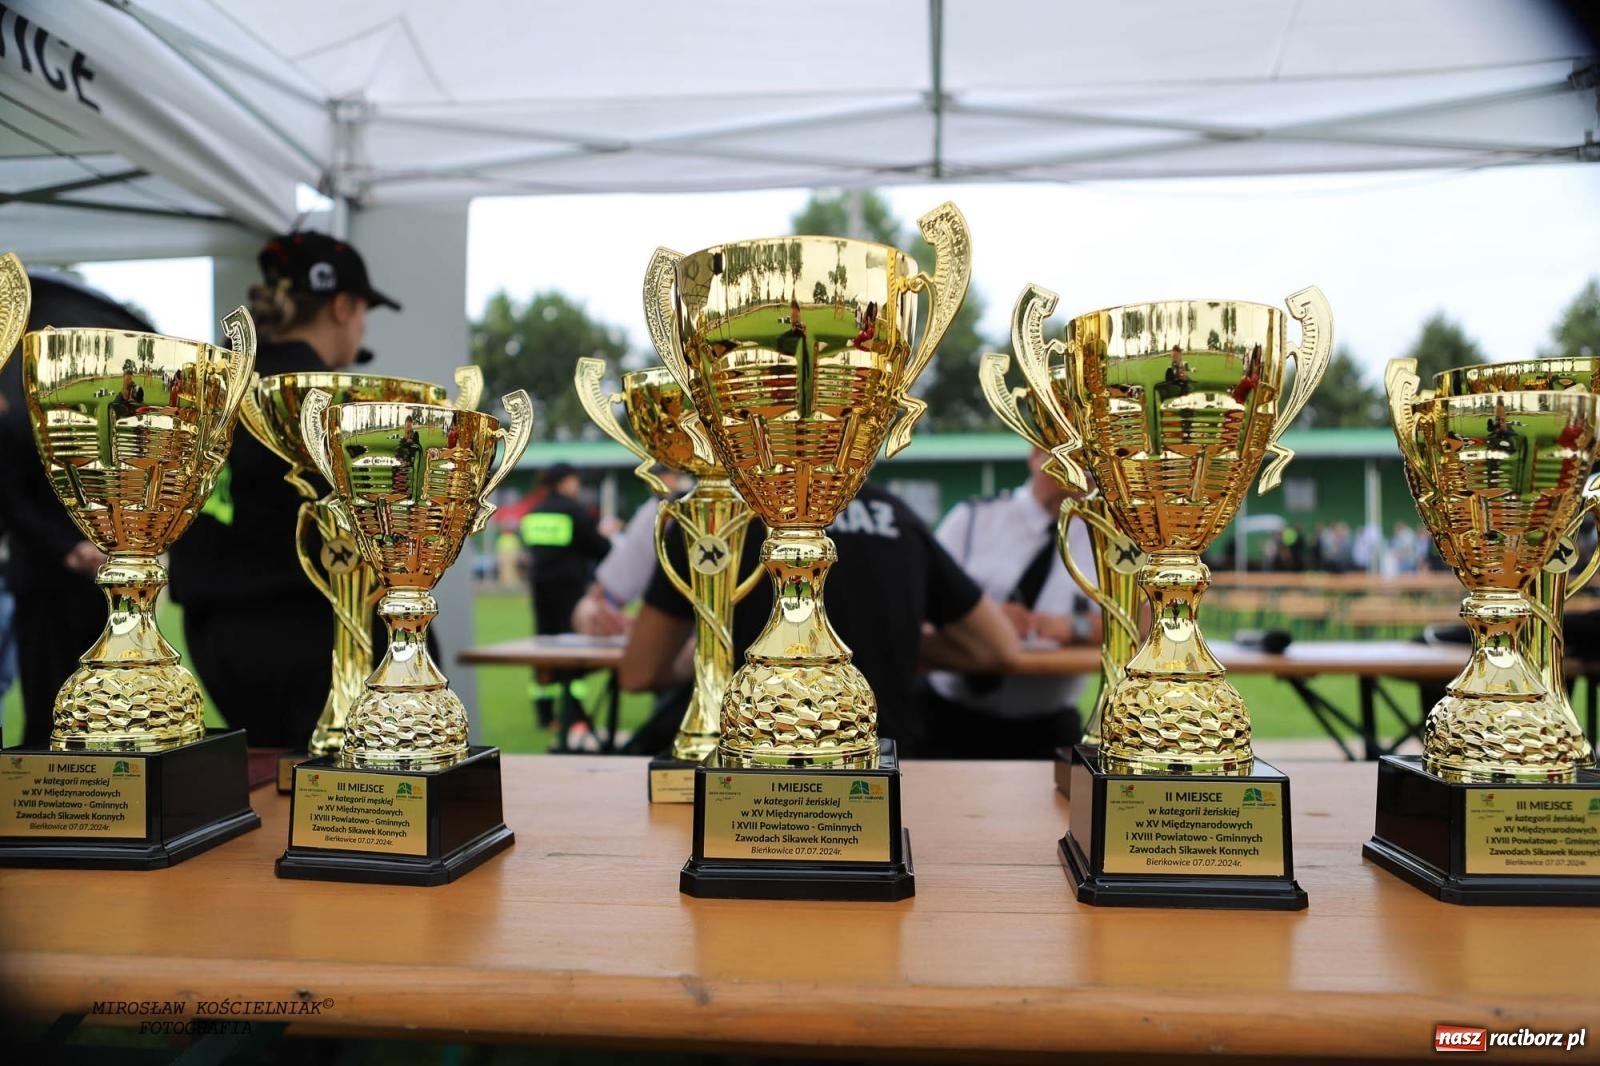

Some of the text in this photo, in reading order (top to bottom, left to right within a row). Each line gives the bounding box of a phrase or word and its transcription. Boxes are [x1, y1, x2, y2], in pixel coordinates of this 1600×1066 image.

[48, 764, 96, 773] II MIEJSCE
[43, 778, 78, 786] kategorii
[772, 782, 822, 792] I MIEJSCE
[44, 789, 120, 798] Międzynarodowych
[348, 784, 384, 793] MIEJSCE
[336, 794, 366, 803] kategorii
[367, 798, 393, 806] męskiej
[1165, 792, 1222, 802] II MIEJSCE
[89, 802, 128, 810] Gminnych
[764, 797, 803, 807] kategorii
[805, 797, 840, 808] żeńskiej
[1530, 801, 1573, 810] MIEJSCE
[336, 805, 403, 816] Międzynarodowych
[766, 810, 852, 820] Międzynarodowych
[1159, 807, 1200, 817] kategorii
[1203, 807, 1240, 818] żeńskiej
[92, 813, 124, 821] Konnych
[332, 815, 369, 824] Powiatowo
[376, 818, 410, 827] Gminnych
[760, 822, 809, 831] Powiatowo
[818, 823, 862, 832] Gminnych
[1162, 820, 1252, 831] Międzynarodowych
[312, 824, 346, 833] Zawodach
[378, 829, 407, 838] Konnych
[736, 834, 858, 845] Zawodach Sikawek Konnych
[1126, 832, 1129, 840] i
[1156, 833, 1207, 841] Powiatowo
[1216, 834, 1262, 843] Gminnych
[1130, 845, 1259, 856] Zawodach Sikawek Konnych
[1146, 858, 1190, 866] Bieńkowice
